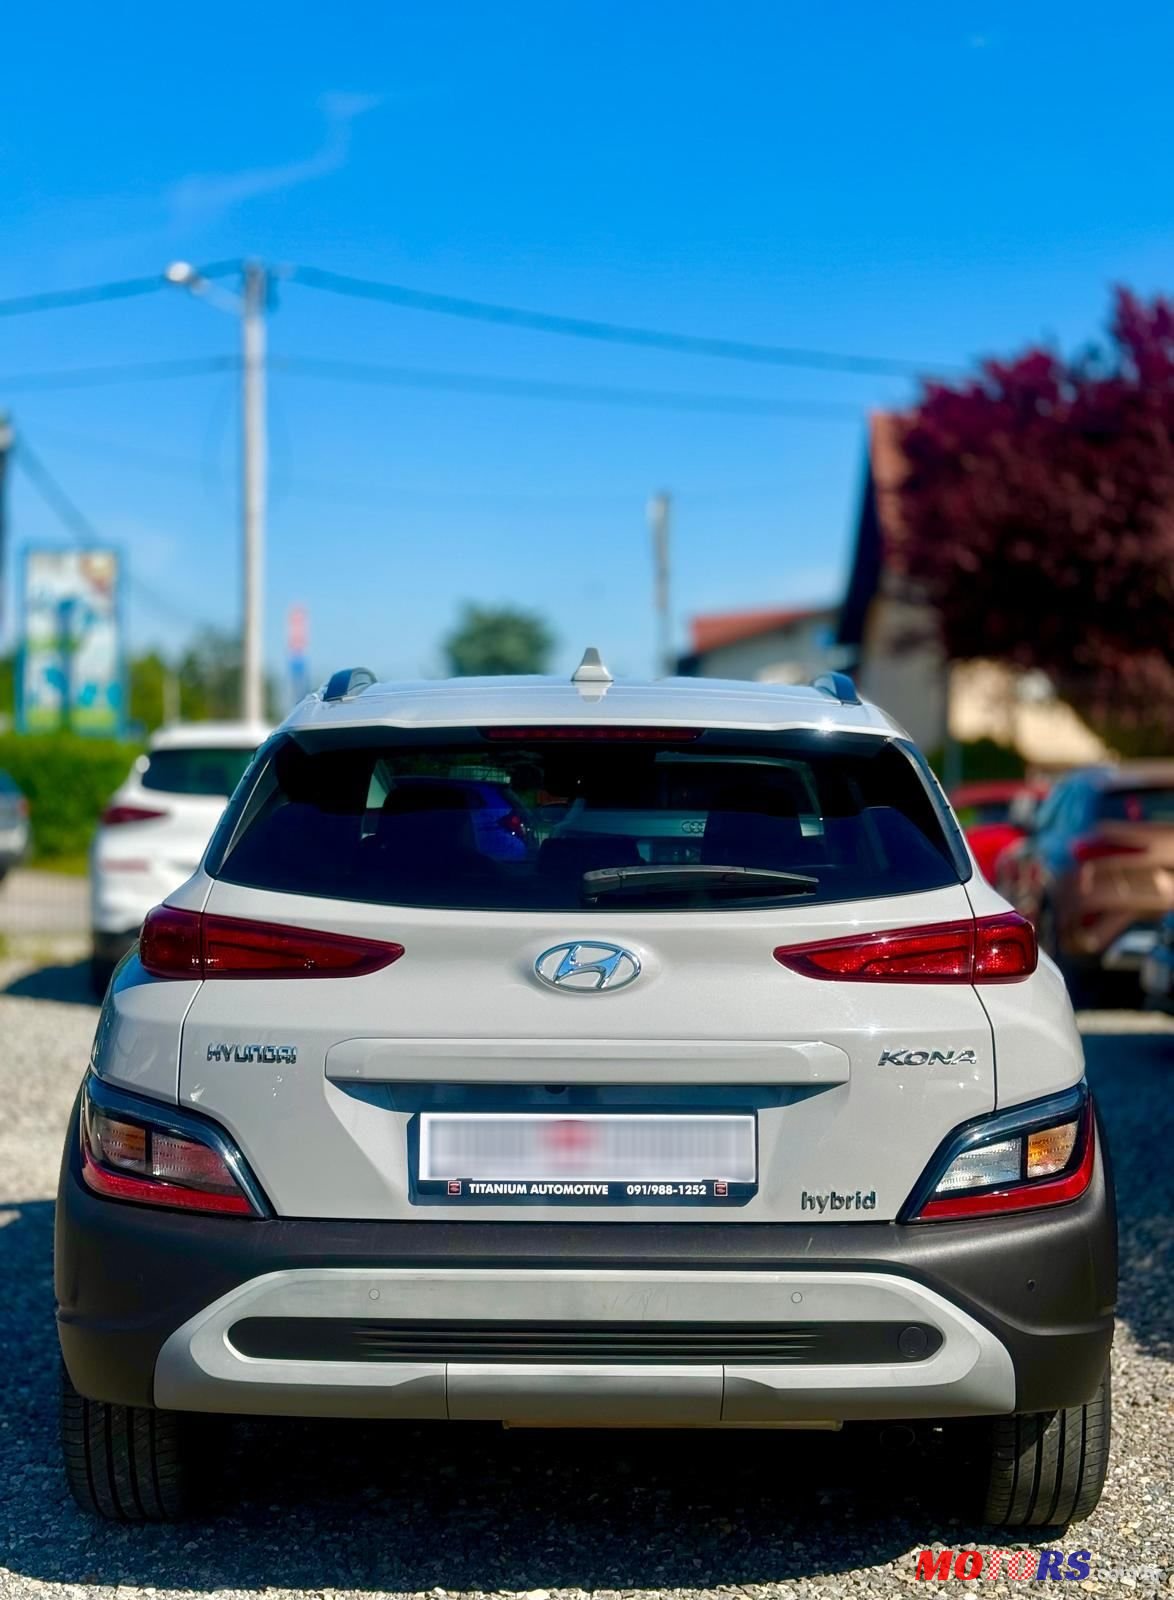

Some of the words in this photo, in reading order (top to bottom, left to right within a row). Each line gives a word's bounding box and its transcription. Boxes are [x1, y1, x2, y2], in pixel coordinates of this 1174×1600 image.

[206, 1043, 298, 1064] HYUNDAI
[878, 1049, 977, 1066] KONA
[469, 1183, 527, 1194] TITANIUM
[529, 1184, 609, 1195] AUTOMOTIVE
[626, 1184, 707, 1195] 091/988-1252
[801, 1191, 876, 1214] hybrid
